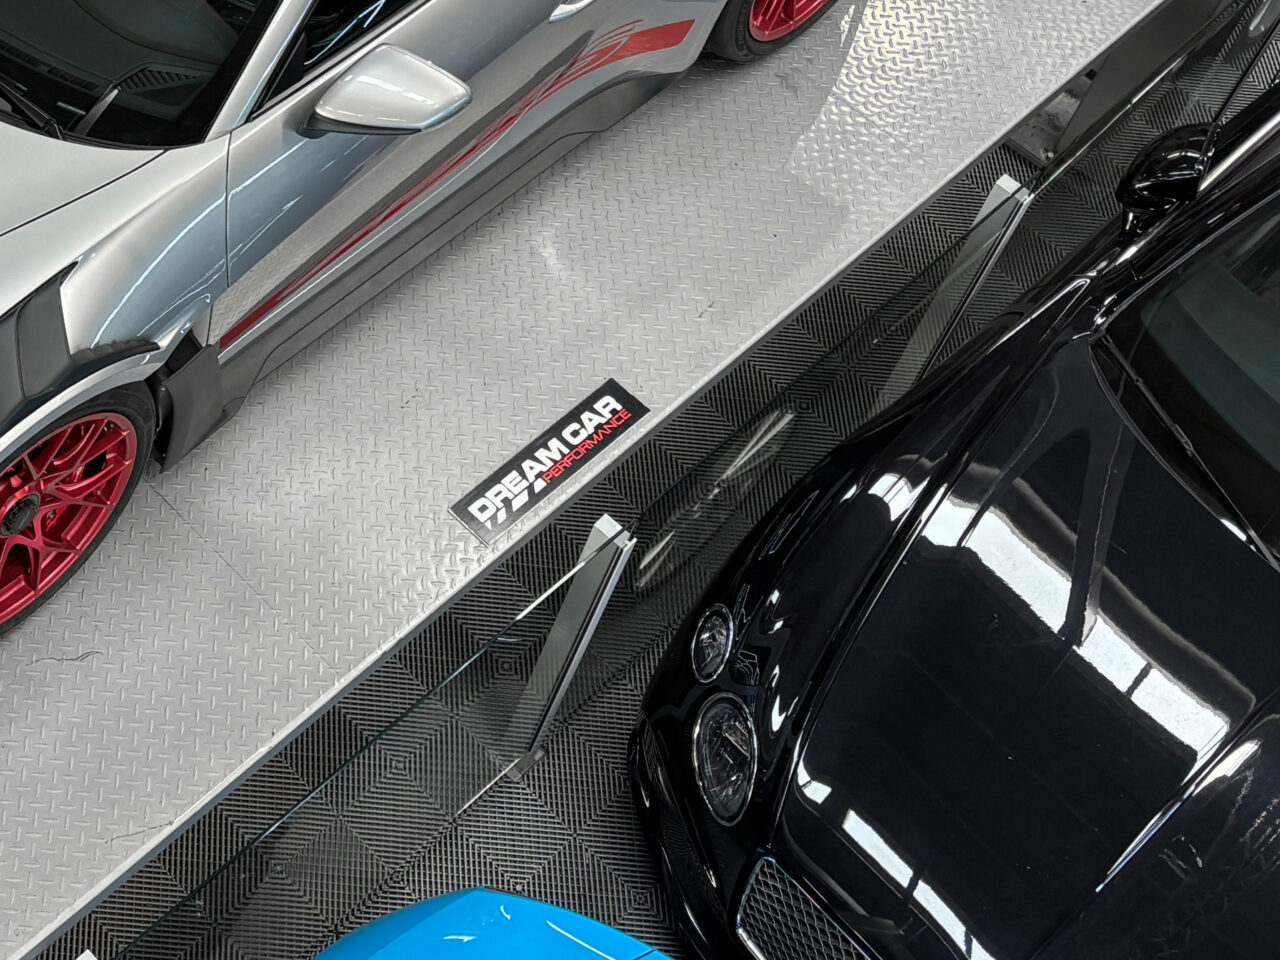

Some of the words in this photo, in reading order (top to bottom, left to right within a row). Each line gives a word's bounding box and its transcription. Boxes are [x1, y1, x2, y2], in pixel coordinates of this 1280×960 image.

[468, 437, 570, 524] DREAM
[561, 395, 623, 446] CAR
[542, 408, 632, 484] PERFORMANCE
